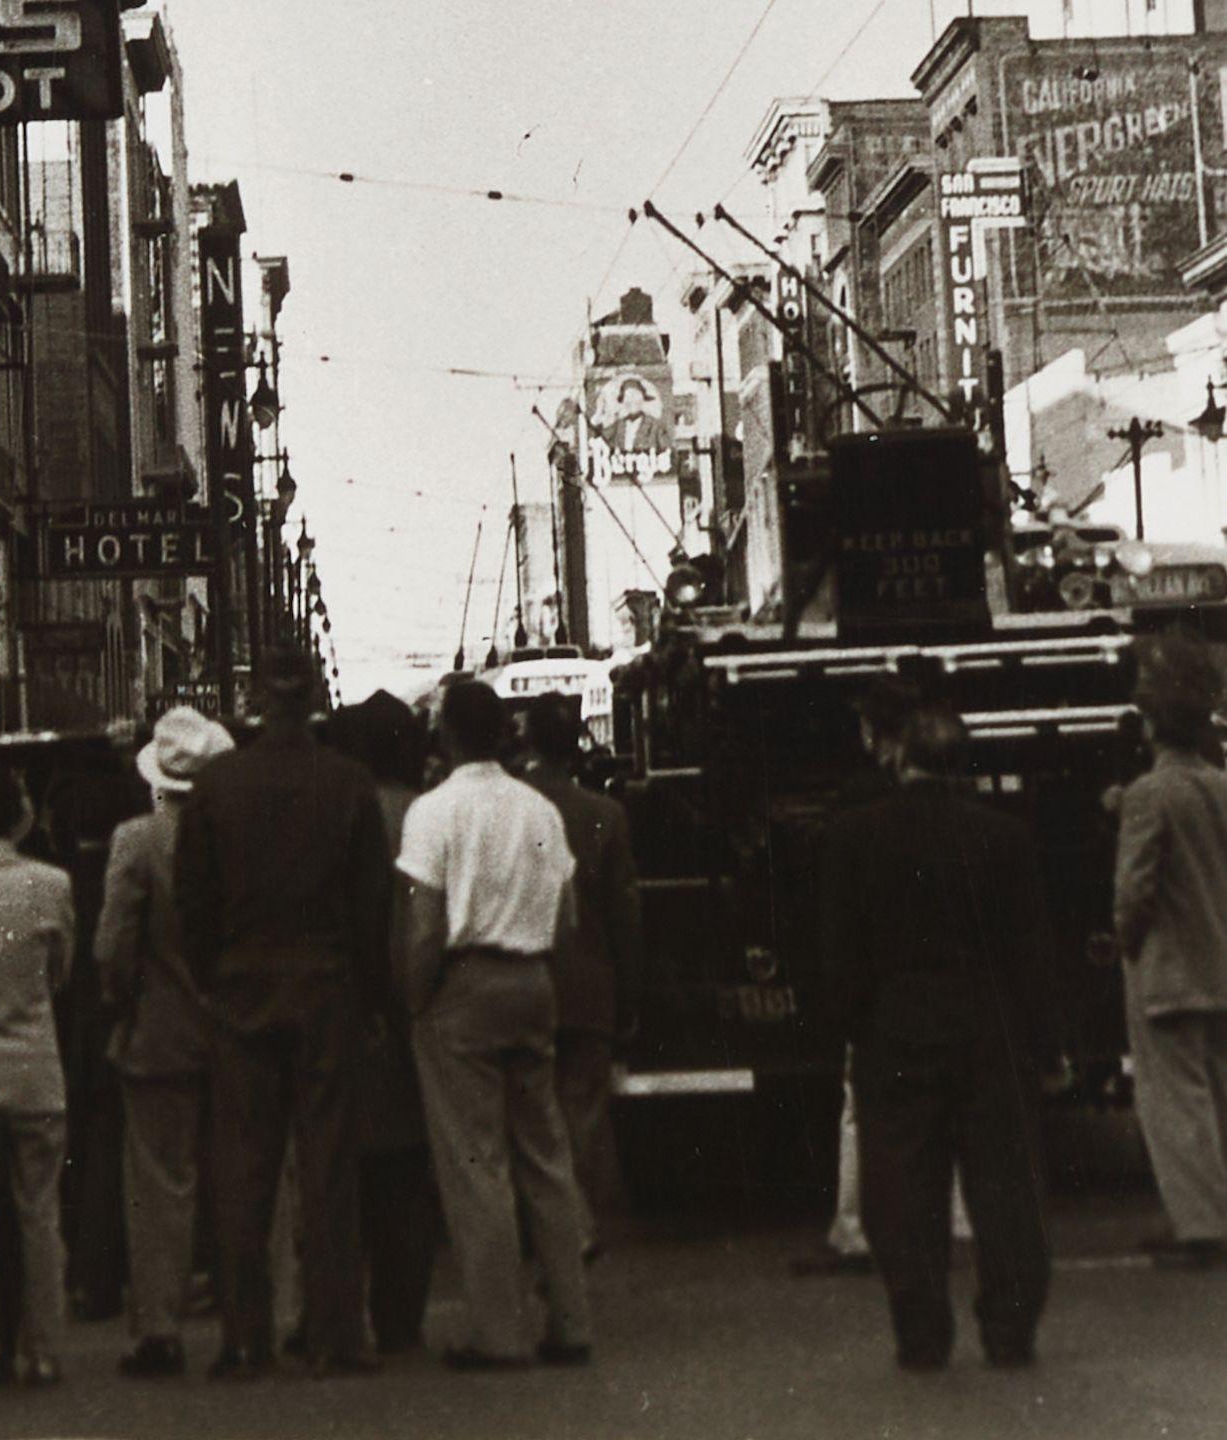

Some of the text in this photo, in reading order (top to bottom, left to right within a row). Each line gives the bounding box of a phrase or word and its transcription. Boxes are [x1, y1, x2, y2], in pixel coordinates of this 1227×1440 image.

[1023, 72, 1137, 115] CALIFORNIA
[940, 172, 976, 195] SAN
[940, 194, 1021, 219] FRANCISCO
[63, 532, 215, 566] HOTEL
